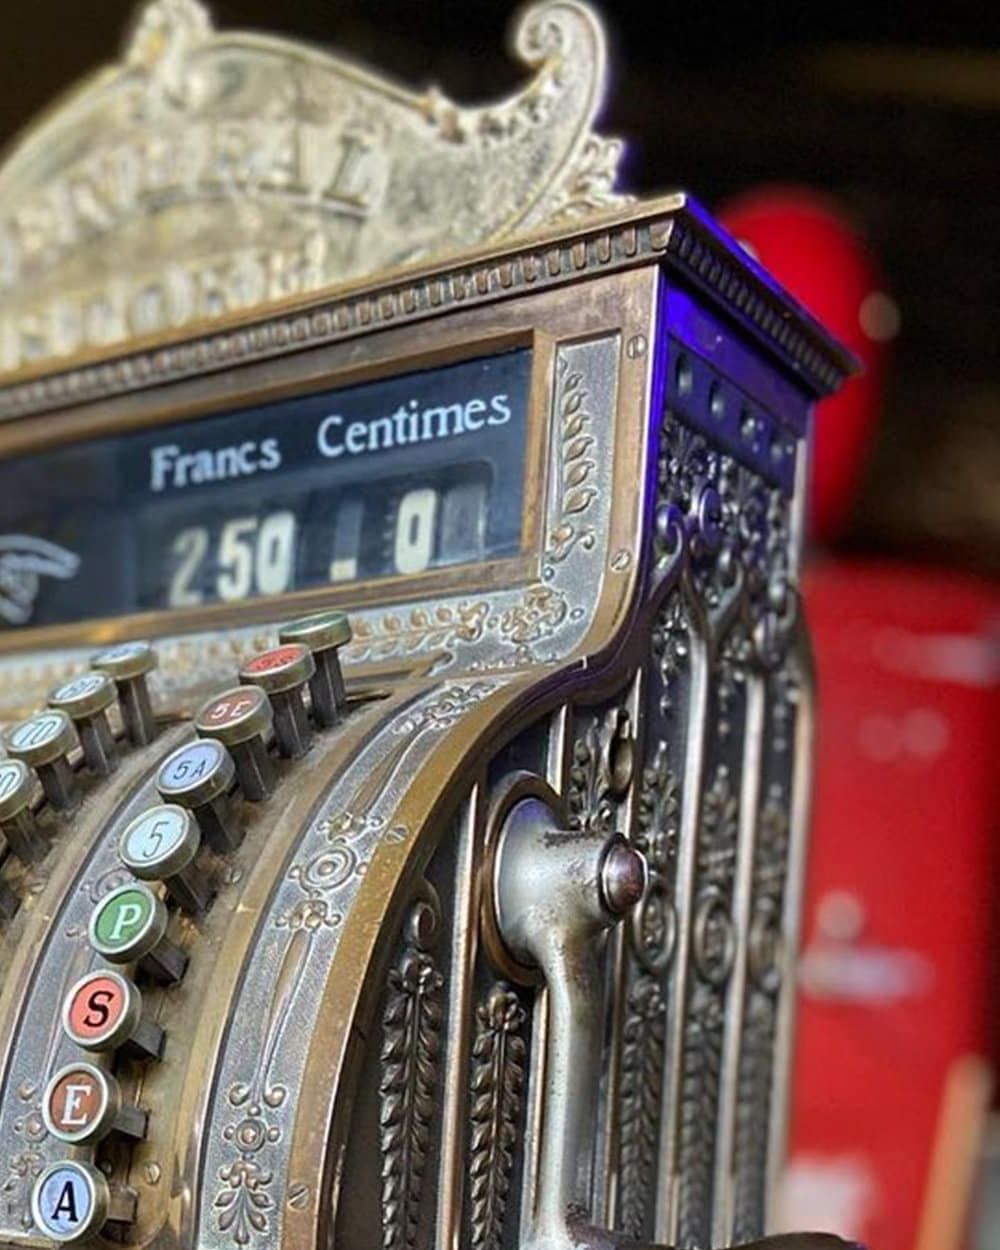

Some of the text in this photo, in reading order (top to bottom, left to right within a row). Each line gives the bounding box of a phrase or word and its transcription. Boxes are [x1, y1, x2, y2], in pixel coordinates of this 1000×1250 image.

[150, 394, 512, 492] Francs Centimes
[19, 720, 57, 745] 70
[143, 820, 169, 858] 5
[108, 903, 141, 940] P
[82, 990, 114, 1028] S
[60, 1084, 93, 1126] E
[52, 1181, 79, 1223] A
